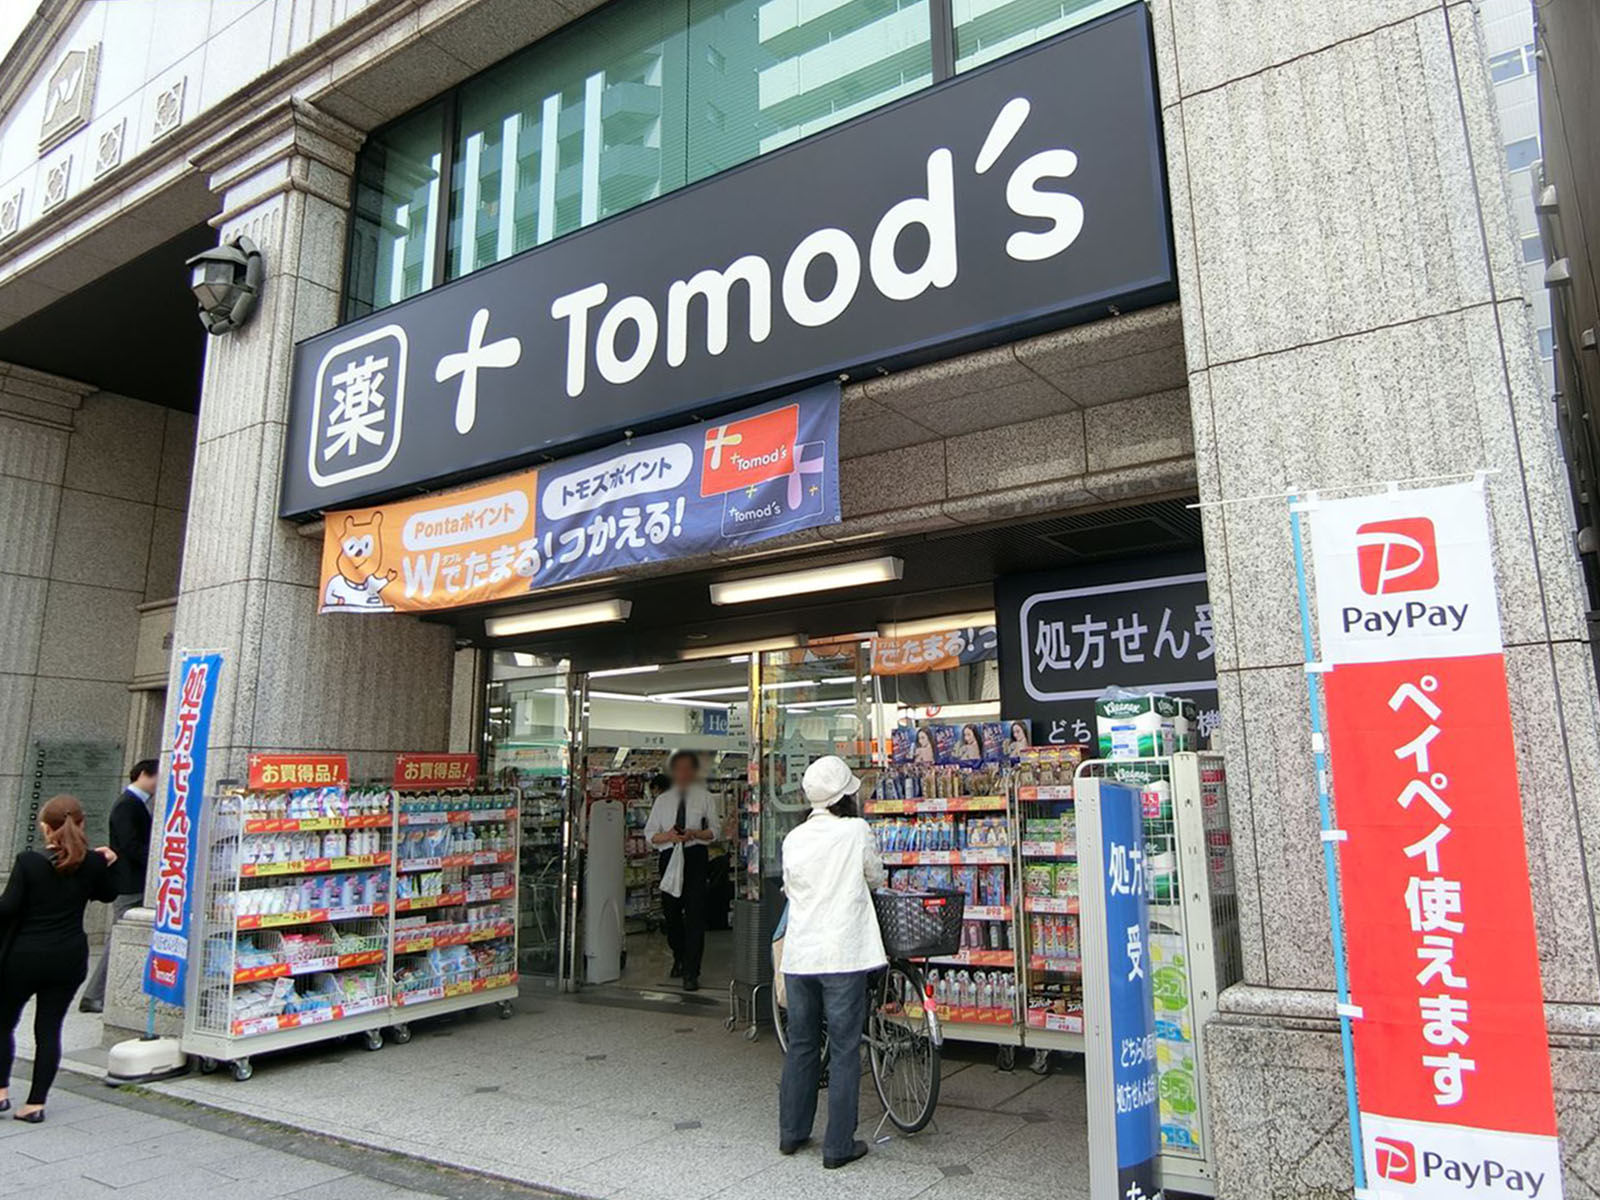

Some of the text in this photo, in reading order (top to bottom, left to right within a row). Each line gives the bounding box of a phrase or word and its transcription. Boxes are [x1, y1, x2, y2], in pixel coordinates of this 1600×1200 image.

[551, 96, 1085, 398] Tomod's
[323, 352, 389, 460] 薬
[735, 445, 788, 472] Tomod's
[413, 501, 516, 541] Pontaポイント
[733, 500, 782, 523] Tomod's
[1341, 601, 1469, 637] PayPay
[261, 763, 340, 784] お買得品!
[403, 761, 470, 781] お買得品!
[156, 662, 208, 930] 処方せん受付
[1387, 674, 1477, 1107] ペイペイ使えます
[1422, 1151, 1545, 1199] PayPay
